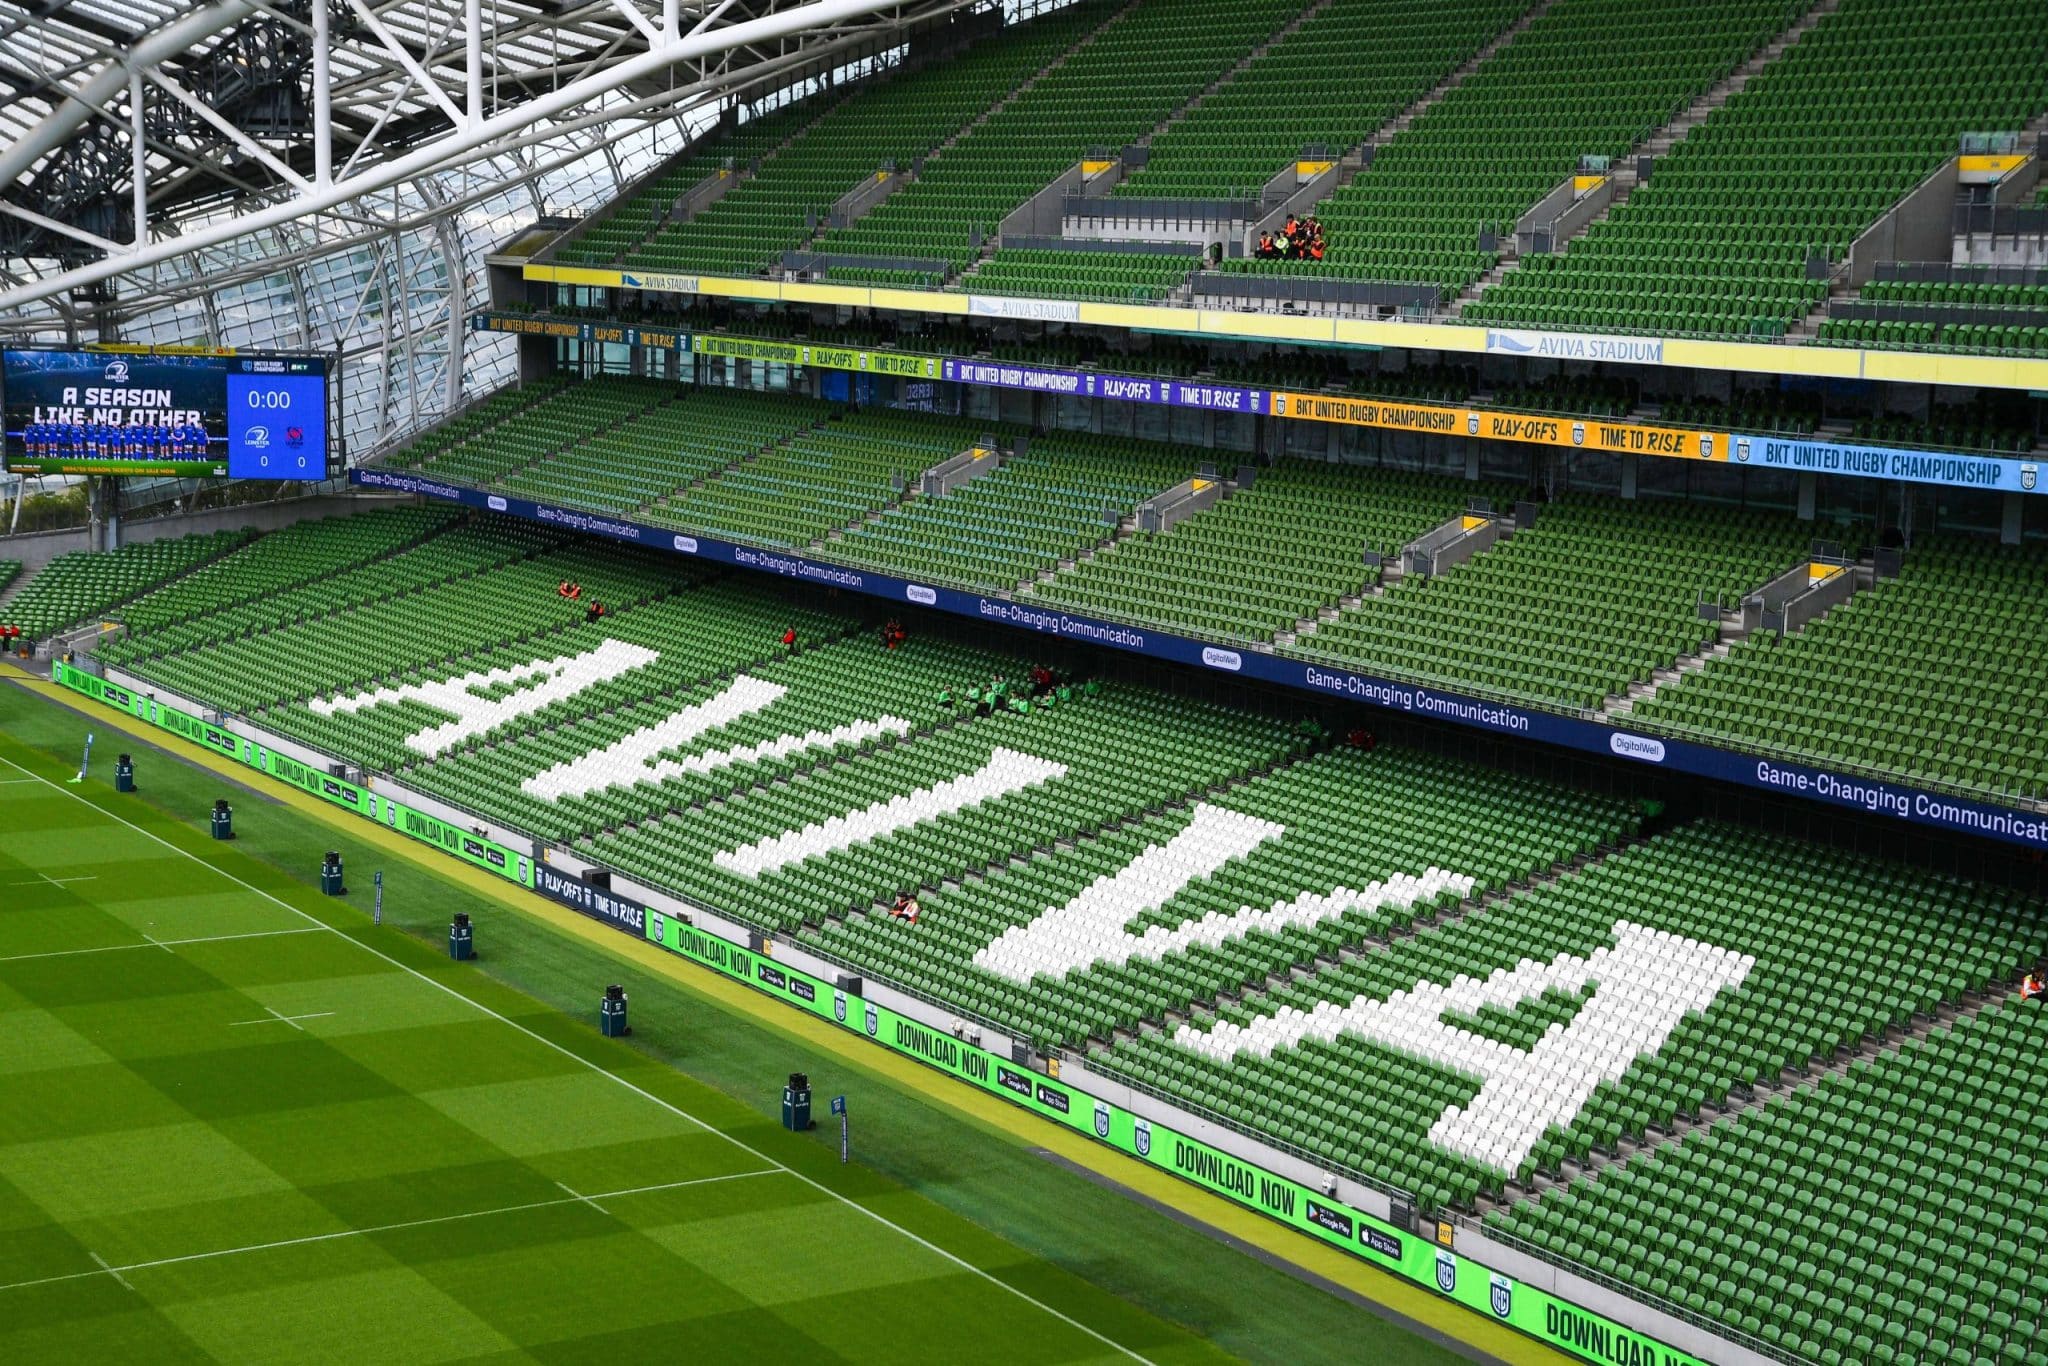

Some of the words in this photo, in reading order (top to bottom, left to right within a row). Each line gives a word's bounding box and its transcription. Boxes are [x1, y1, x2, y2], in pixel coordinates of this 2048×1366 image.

[644, 276, 666, 289] AVIVA
[666, 278, 698, 291] STADIUM
[1001, 303, 1031, 317] AVIVA
[1032, 304, 1079, 321] STADIUM
[502, 319, 523, 331] UNITED
[524, 321, 544, 333] RUGBY
[544, 323, 579, 337] CHAMPIONSHIP
[639, 332, 653, 346] TIME
[653, 333, 659, 346] TO
[659, 334, 676, 348] RISE
[706, 338, 717, 352] BKT
[717, 340, 736, 354] UNITED
[737, 342, 754, 357] RUGBY
[754, 343, 797, 361] CHAMPIONSHIP
[1538, 337, 1583, 357] AVIVA
[1588, 339, 1662, 362] STADIUM
[874, 356, 889, 371] TIME
[890, 357, 898, 371] TO
[899, 358, 919, 374] RISE
[961, 364, 974, 380] BKT
[975, 366, 999, 383] UNITED
[1000, 368, 1022, 387] RUGBY
[1024, 371, 1078, 392] CHAMPIONSHIP
[63, 387, 77, 405] A
[85, 388, 171, 407] SEASON
[248, 391, 290, 409] 0:00
[1180, 386, 1200, 405] TIME
[1201, 388, 1211, 405] TO
[1213, 388, 1240, 409] RISE
[34, 406, 90, 426] LIKE
[93, 408, 121, 427] NO
[130, 408, 200, 428] OTHER
[1297, 398, 1313, 416] BKT
[1316, 400, 1347, 420] UNITED
[1349, 403, 1379, 423] RUGBY
[1381, 406, 1455, 431] CHAMPIONSHIP
[1600, 427, 1626, 448] TIME
[1630, 430, 1643, 449] TO
[1647, 431, 1686, 453] RISE
[260, 456, 268, 467] 0
[298, 456, 306, 468] 0
[1766, 443, 1791, 465] BKT
[1794, 445, 1839, 469] UNITED
[1843, 450, 1888, 474] RUGBY
[1891, 456, 2001, 485] CHAMPIONSHIP
[360, 471, 417, 492] Game-Changing
[417, 481, 460, 500] Communication
[536, 505, 587, 530] Game-Changing
[587, 515, 640, 538] Communication
[735, 547, 797, 576] Game-Changing
[798, 560, 863, 588] Communication
[908, 588, 934, 602] DigitalWell
[980, 599, 1059, 633] Game-Changing
[1060, 616, 1144, 648] Communication
[1206, 650, 1239, 666] DigitalWell
[1306, 667, 1412, 710] Game-Changing
[1415, 691, 1529, 731] Communication
[163, 708, 190, 735] DOWNLOAD
[191, 722, 203, 740] NOW
[1616, 737, 1660, 756] DigitalWell
[274, 756, 305, 787] DOWNLOAD
[306, 766, 320, 791] NOW
[1757, 761, 1909, 816] Game-Changing
[405, 812, 441, 844] DOWNLOAD
[443, 828, 459, 851] NOW
[594, 893, 609, 914] TIME
[610, 900, 618, 917] TO
[619, 903, 643, 929] RISE
[679, 927, 727, 967] DOWNLOAD
[730, 947, 752, 977] NOW
[896, 1020, 957, 1068] DOWNLOAD
[962, 1048, 989, 1082] NOW
[1176, 1140, 1254, 1199] DOWNLOAD
[1260, 1177, 1295, 1218] NOW
[1319, 1213, 1338, 1229] Google
[1339, 1221, 1350, 1236] Play
[1370, 1236, 1383, 1249] App
[1383, 1241, 1399, 1257] Store
[1546, 1302, 1656, 1366] DOWNLOAD
